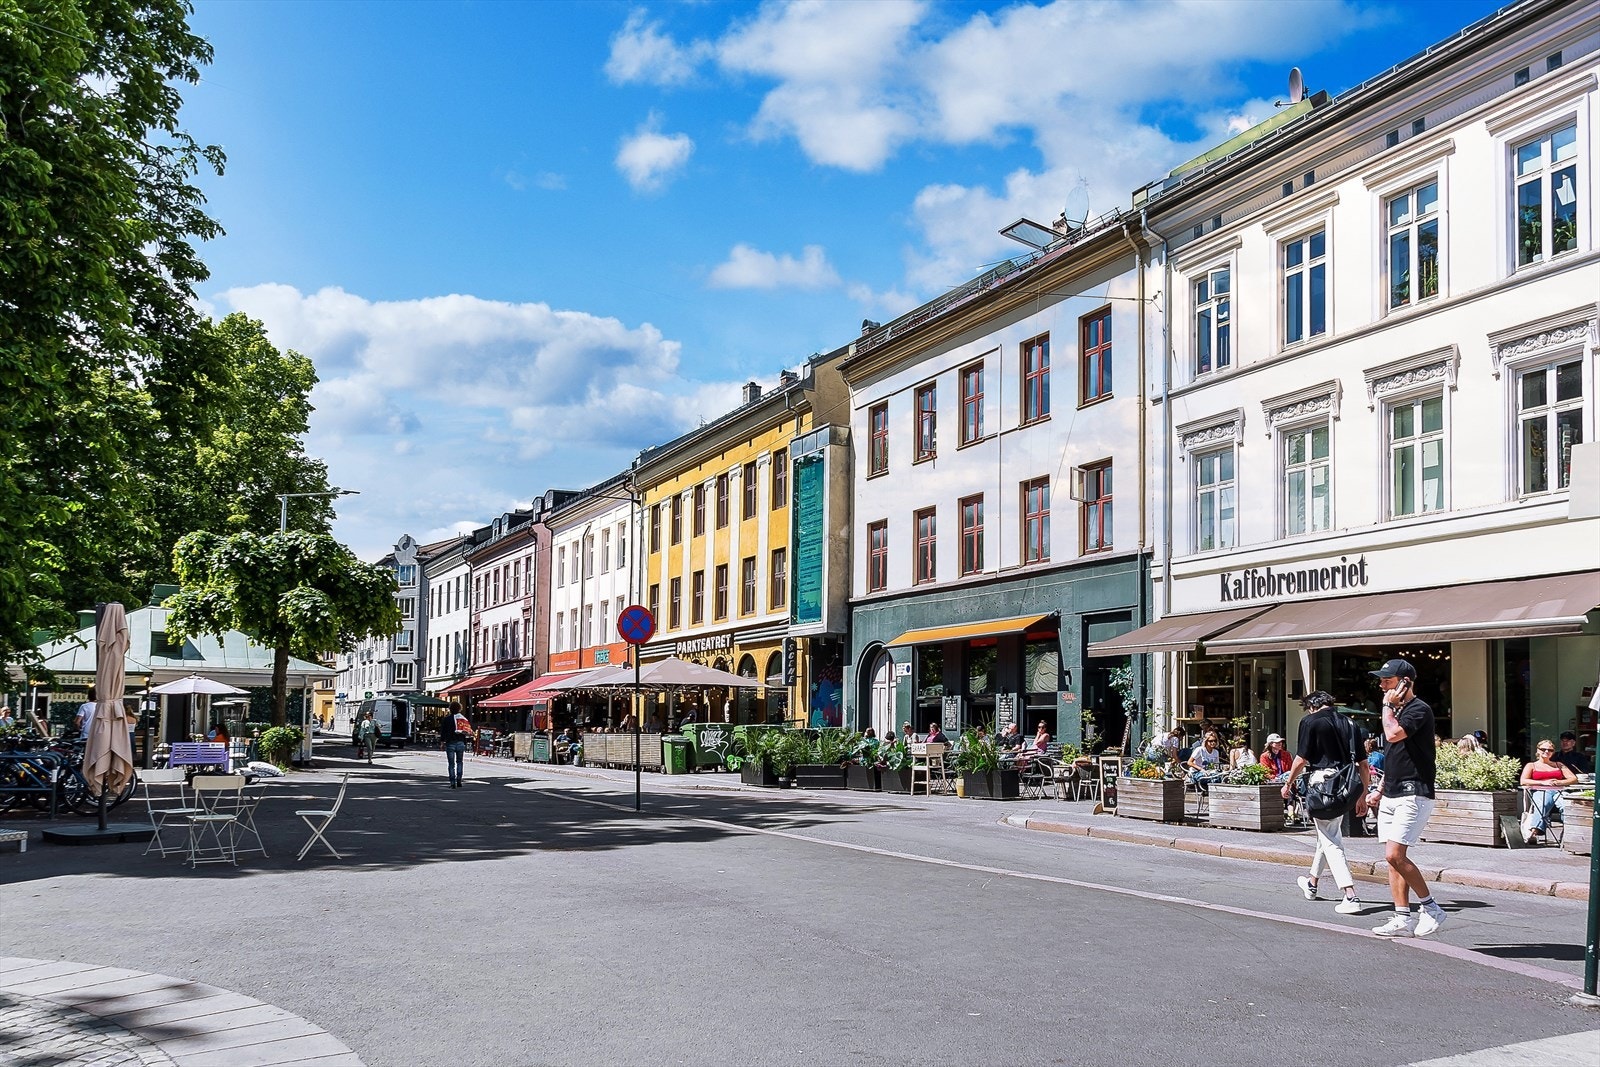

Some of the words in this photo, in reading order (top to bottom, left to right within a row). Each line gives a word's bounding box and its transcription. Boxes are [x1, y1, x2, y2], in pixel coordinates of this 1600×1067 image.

[1220, 553, 1369, 602] Kaffebrenneriet
[676, 634, 732, 655] PARKTEATRET
[788, 643, 796, 683] SCENE
